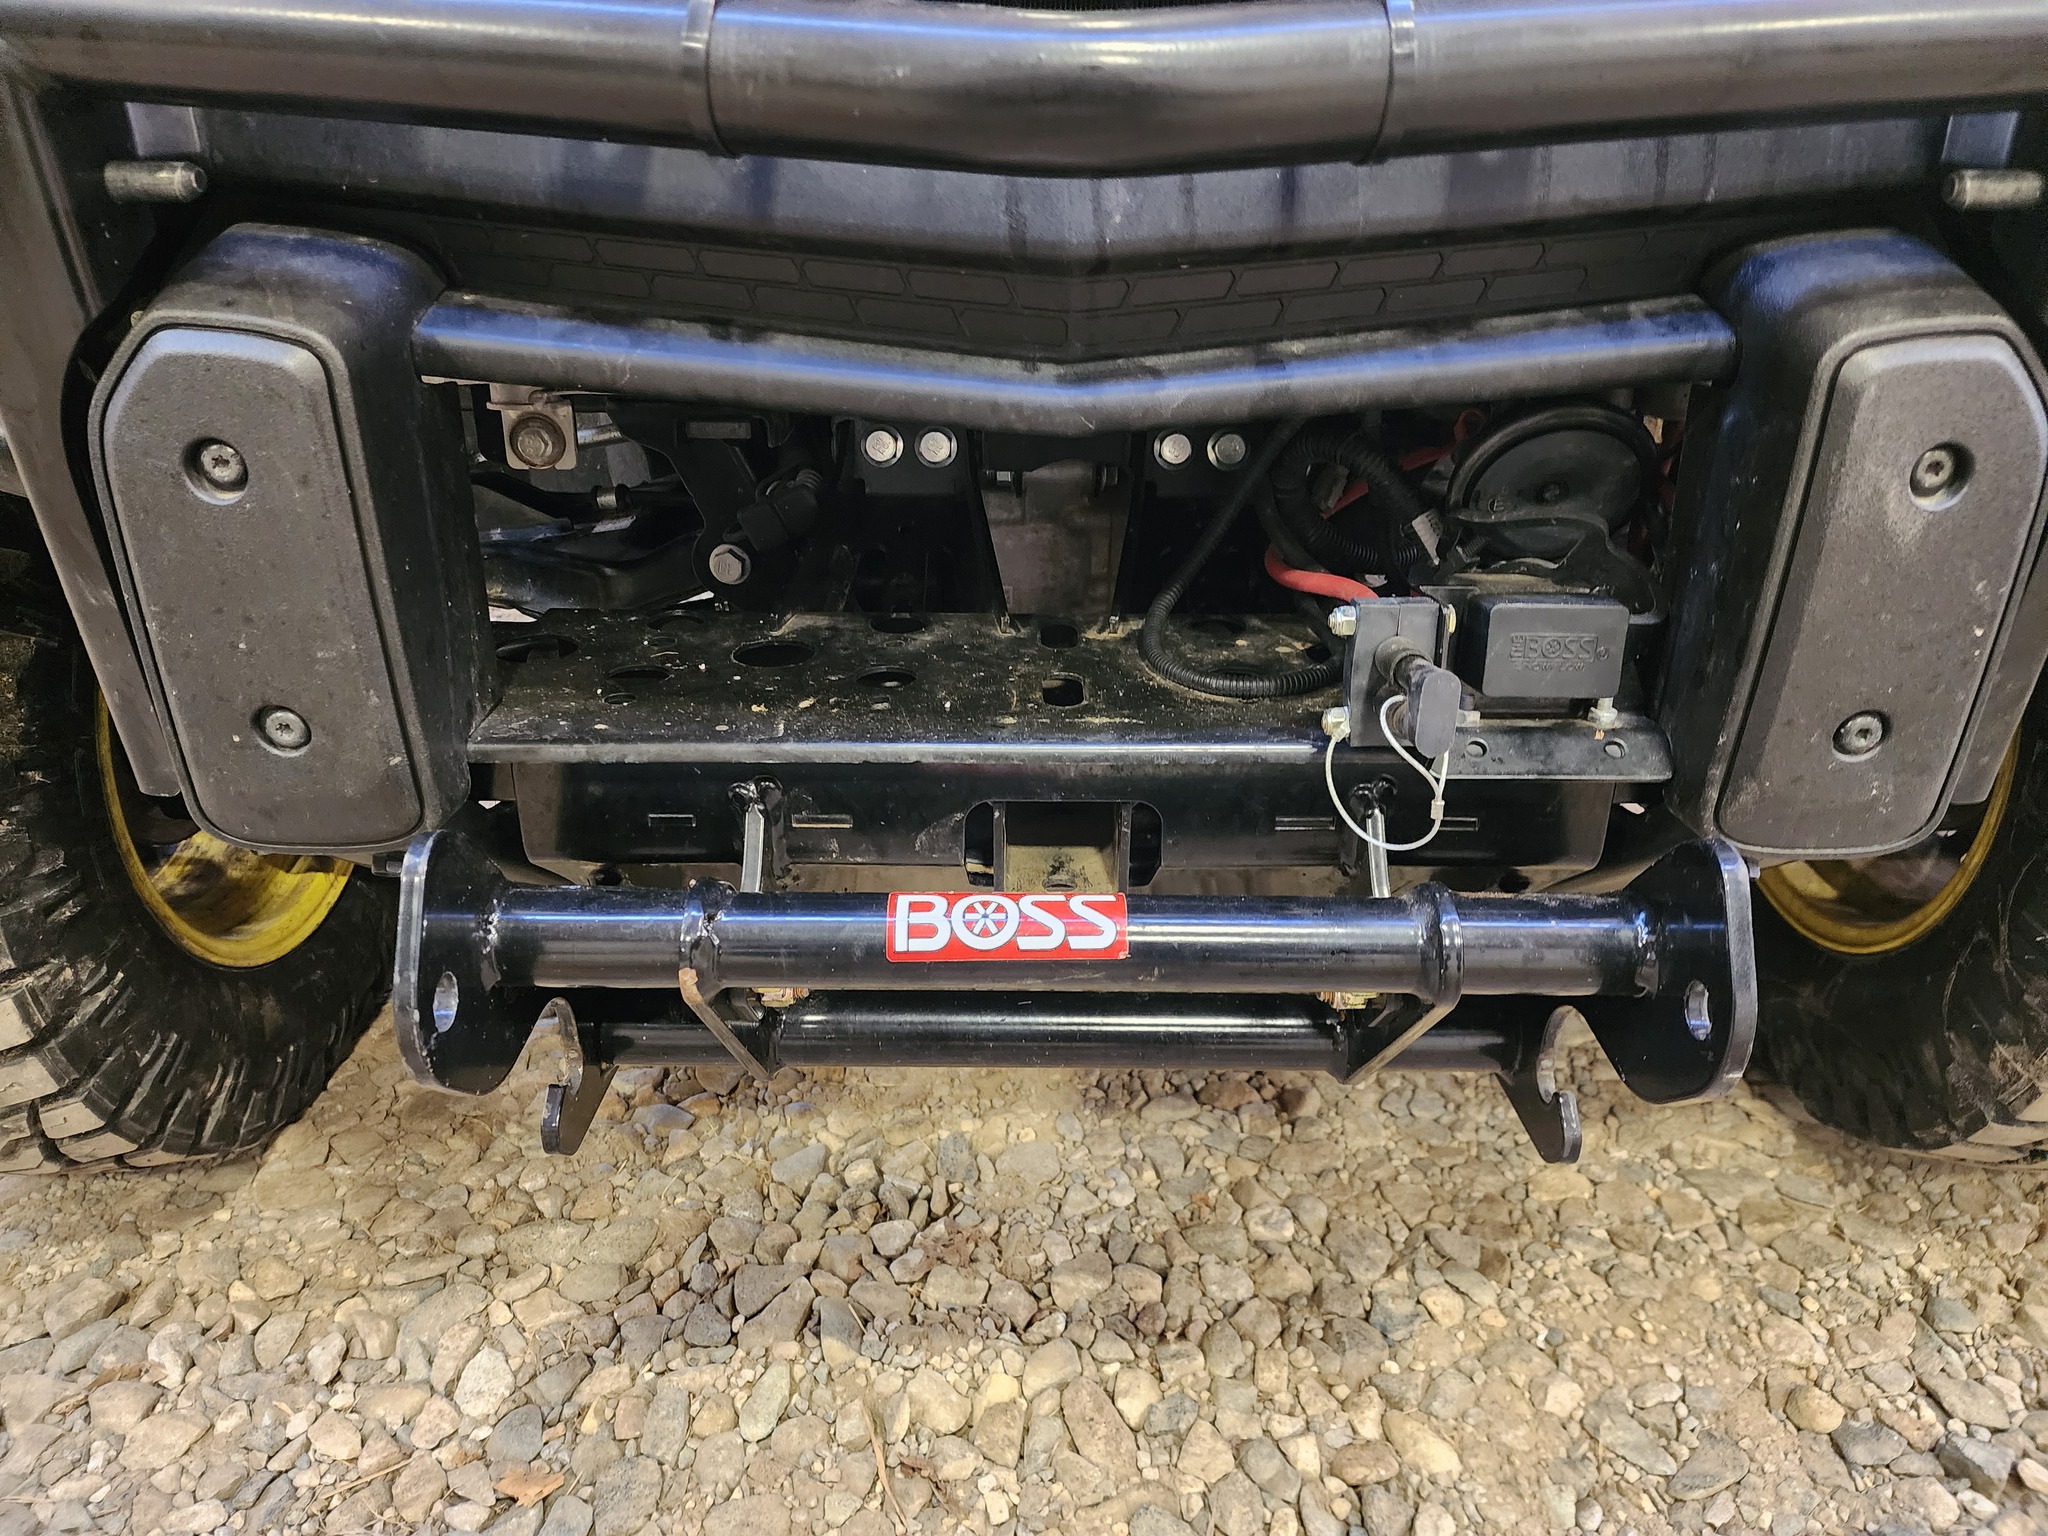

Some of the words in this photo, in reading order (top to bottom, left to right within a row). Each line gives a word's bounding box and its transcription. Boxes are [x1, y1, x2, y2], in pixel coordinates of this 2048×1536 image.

[1510, 635, 1525, 659] THE
[1526, 636, 1595, 660] BOSS
[894, 894, 1118, 952] BOSS
